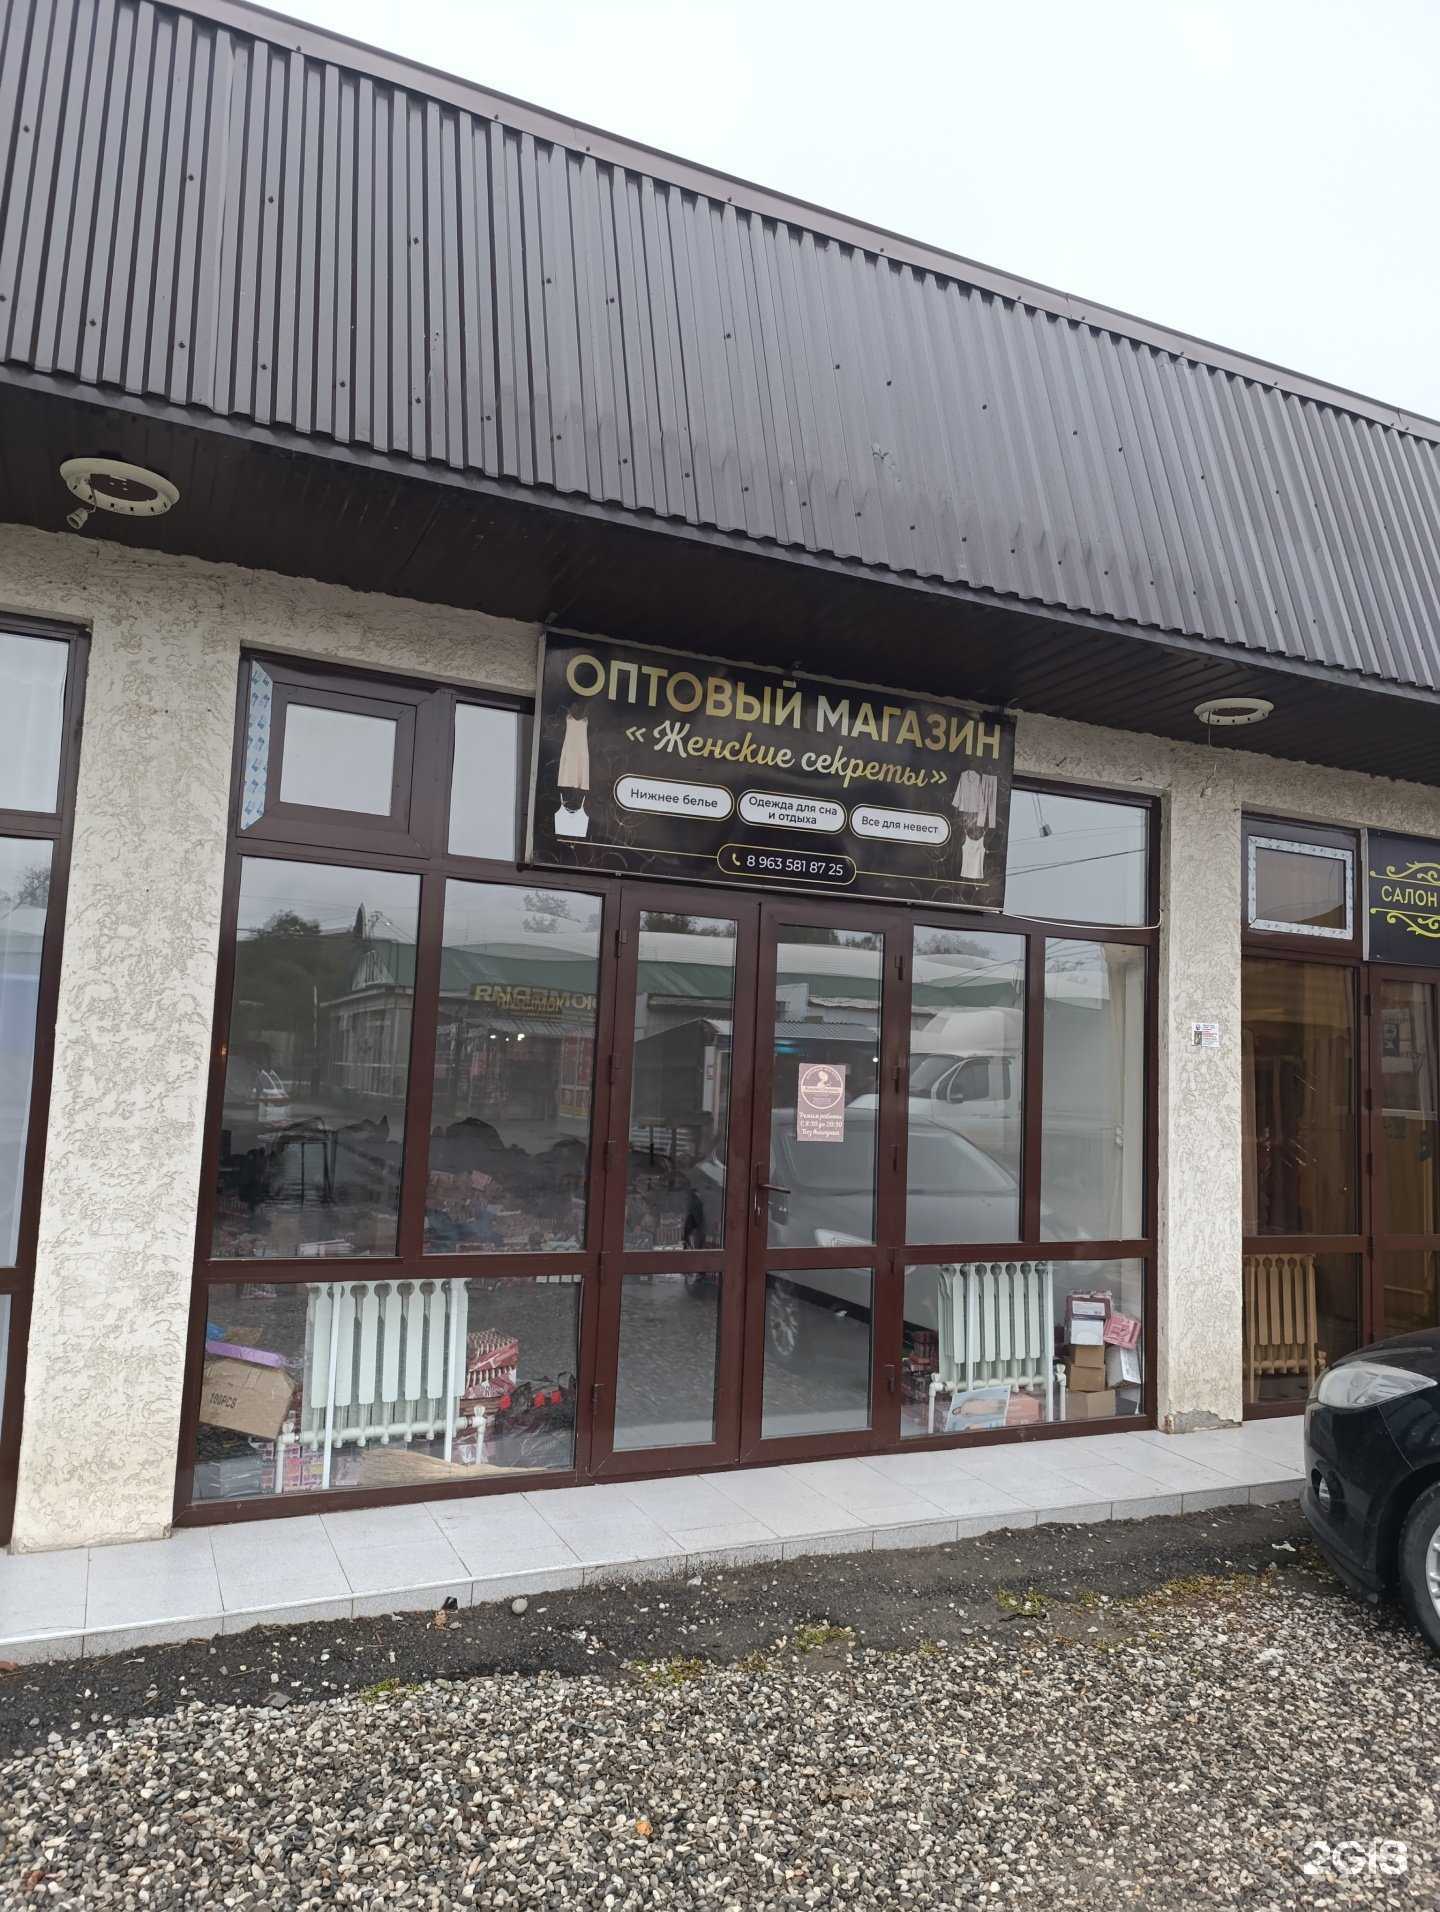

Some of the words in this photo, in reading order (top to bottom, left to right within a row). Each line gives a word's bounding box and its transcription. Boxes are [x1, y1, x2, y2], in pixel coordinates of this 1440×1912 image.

[566, 654, 803, 730] ОПТОВЫЙ
[816, 695, 1001, 760] МАГАЗИН
[801, 745, 948, 789] секреты»
[630, 788, 679, 804] Нижнее
[682, 794, 718, 808] белье
[748, 796, 794, 811] Одежда
[796, 803, 816, 815] для
[818, 806, 838, 816] сна
[768, 812, 776, 821] и
[778, 813, 817, 825] отдыха
[861, 815, 880, 827] Все
[881, 818, 901, 830] для
[903, 823, 939, 834] невест
[746, 855, 756, 867] 8
[758, 856, 782, 869] 963
[786, 858, 806, 872] 581
[809, 861, 826, 874] 87
[829, 863, 844, 876] 25
[1381, 885, 1438, 908] САЛОН
